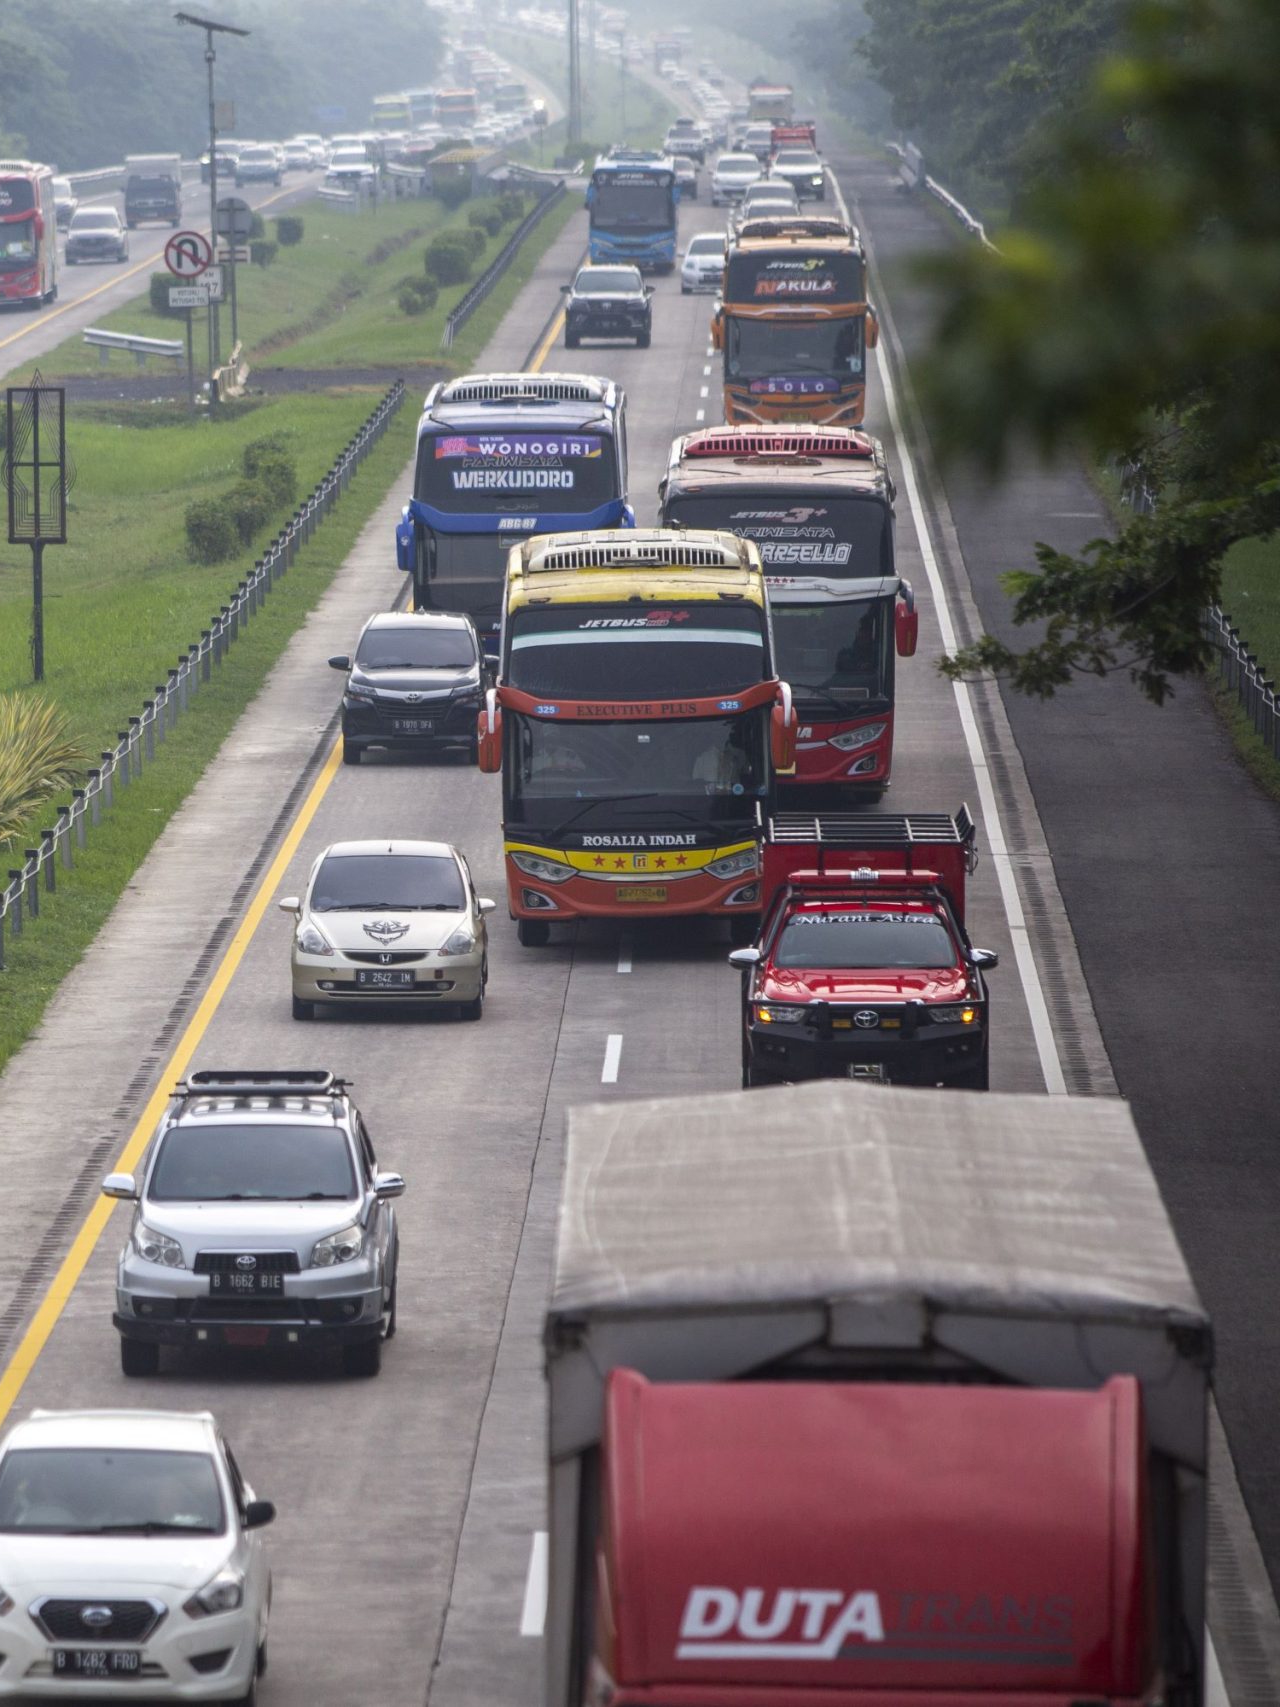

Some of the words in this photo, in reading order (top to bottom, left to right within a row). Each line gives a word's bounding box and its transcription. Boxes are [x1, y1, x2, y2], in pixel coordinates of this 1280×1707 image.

[754, 280, 833, 296] NAKULA
[768, 382, 824, 392] SOLO
[479, 443, 589, 455] WONOGIRI
[462, 455, 564, 468] PARIWISATA
[453, 470, 574, 489] WERKUDORO
[755, 542, 852, 565] ARSELLO
[578, 618, 649, 629] JETBUS
[537, 705, 556, 714] 325
[576, 704, 653, 716] EXECUTIVE
[661, 703, 697, 714] PLUS
[721, 701, 739, 710] 325
[582, 835, 647, 846] ROSALIA
[649, 834, 697, 845] INDAH
[795, 913, 871, 925] Nurani
[877, 913, 935, 924] Astra
[360, 972, 366, 982] B
[214, 1274, 221, 1288] B
[679, 1586, 885, 1642] DUTA
[888, 1591, 1075, 1634] TRANS
[57, 1652, 66, 1668] B
